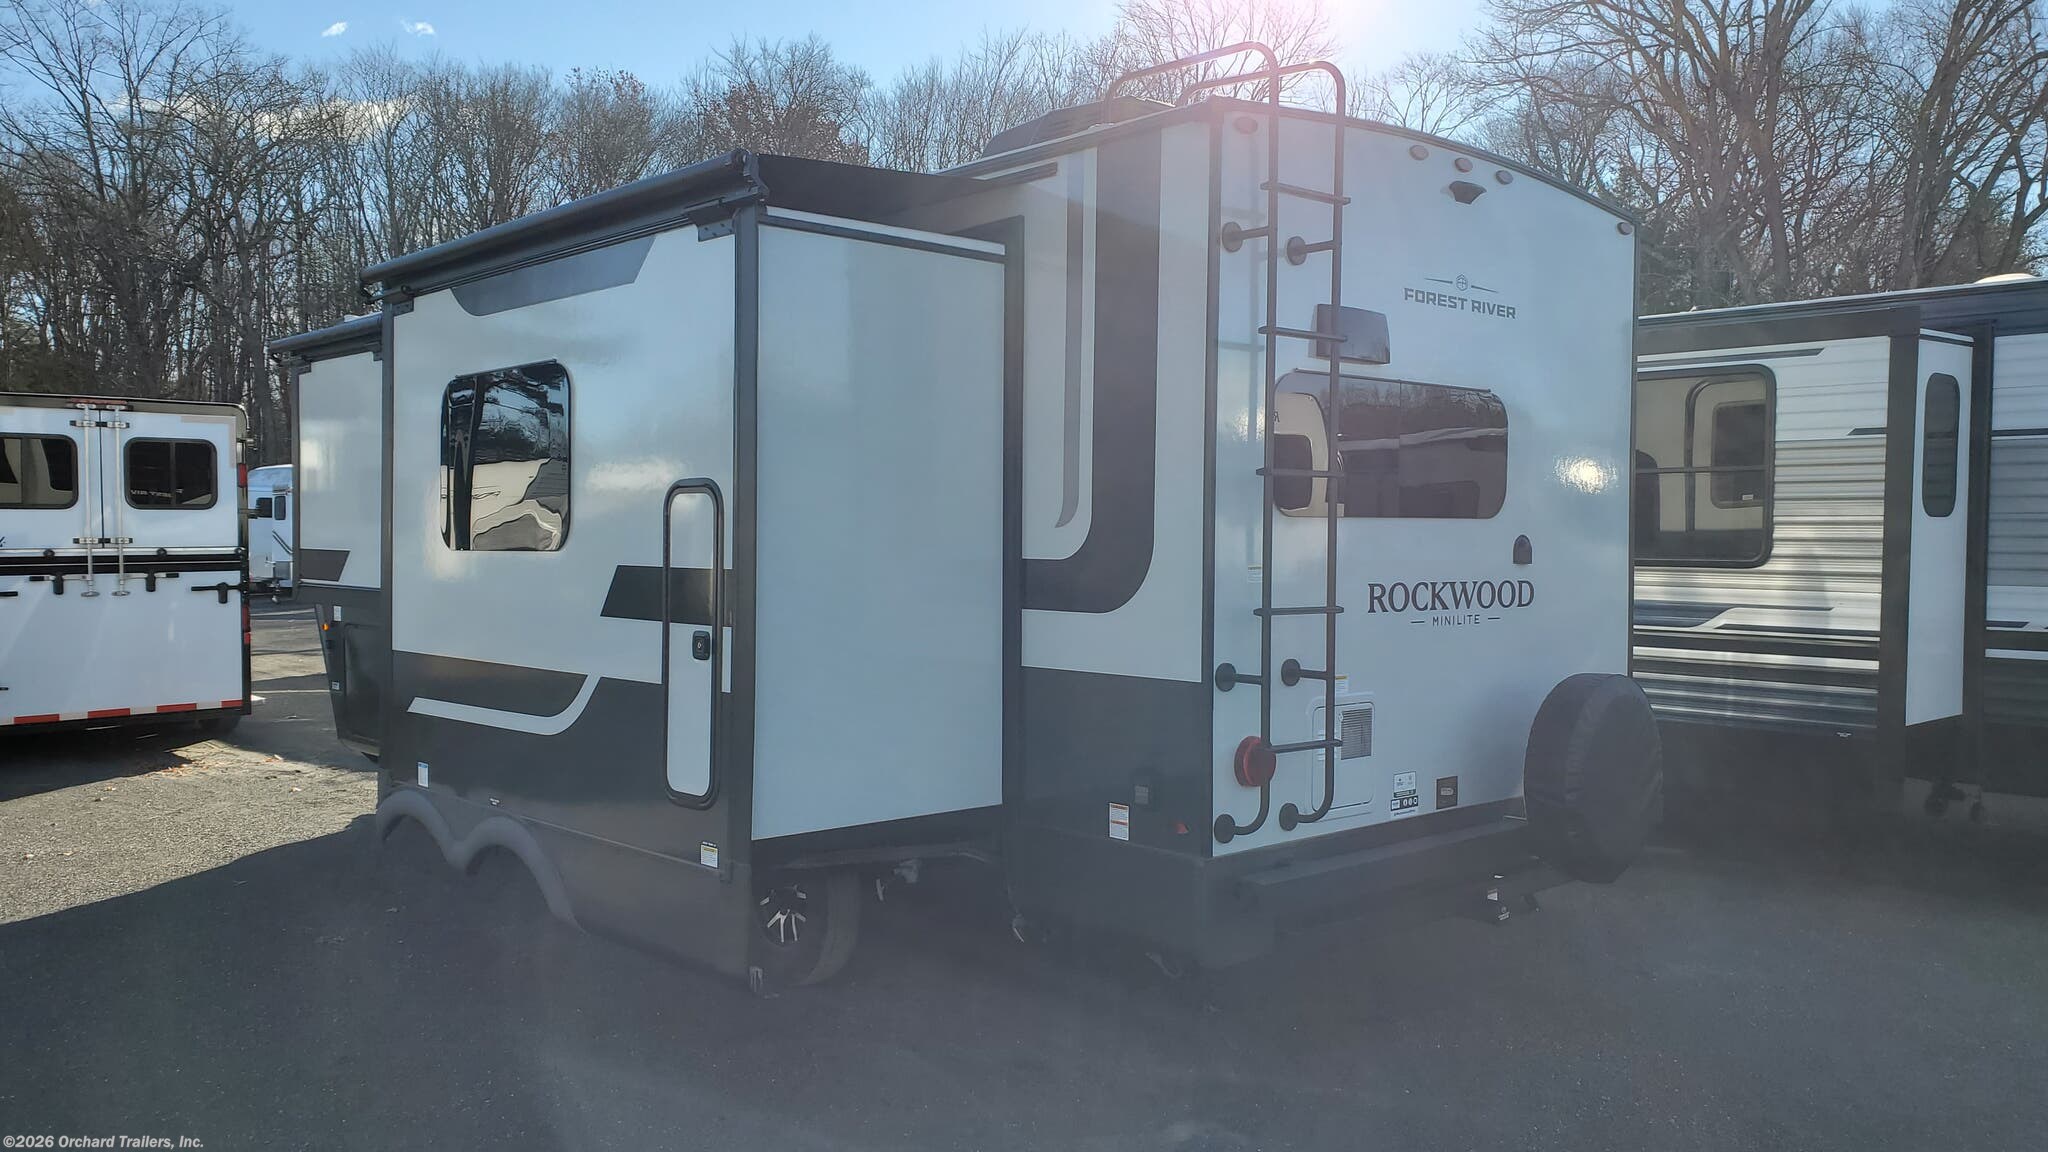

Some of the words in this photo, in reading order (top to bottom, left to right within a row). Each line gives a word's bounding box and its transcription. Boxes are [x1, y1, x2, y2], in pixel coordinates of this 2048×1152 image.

[1404, 287, 1468, 310] FOREST
[1471, 299, 1516, 319] RIVER
[1368, 580, 1535, 613] ROCKWOOD
[1432, 614, 1481, 626] MINILITE
